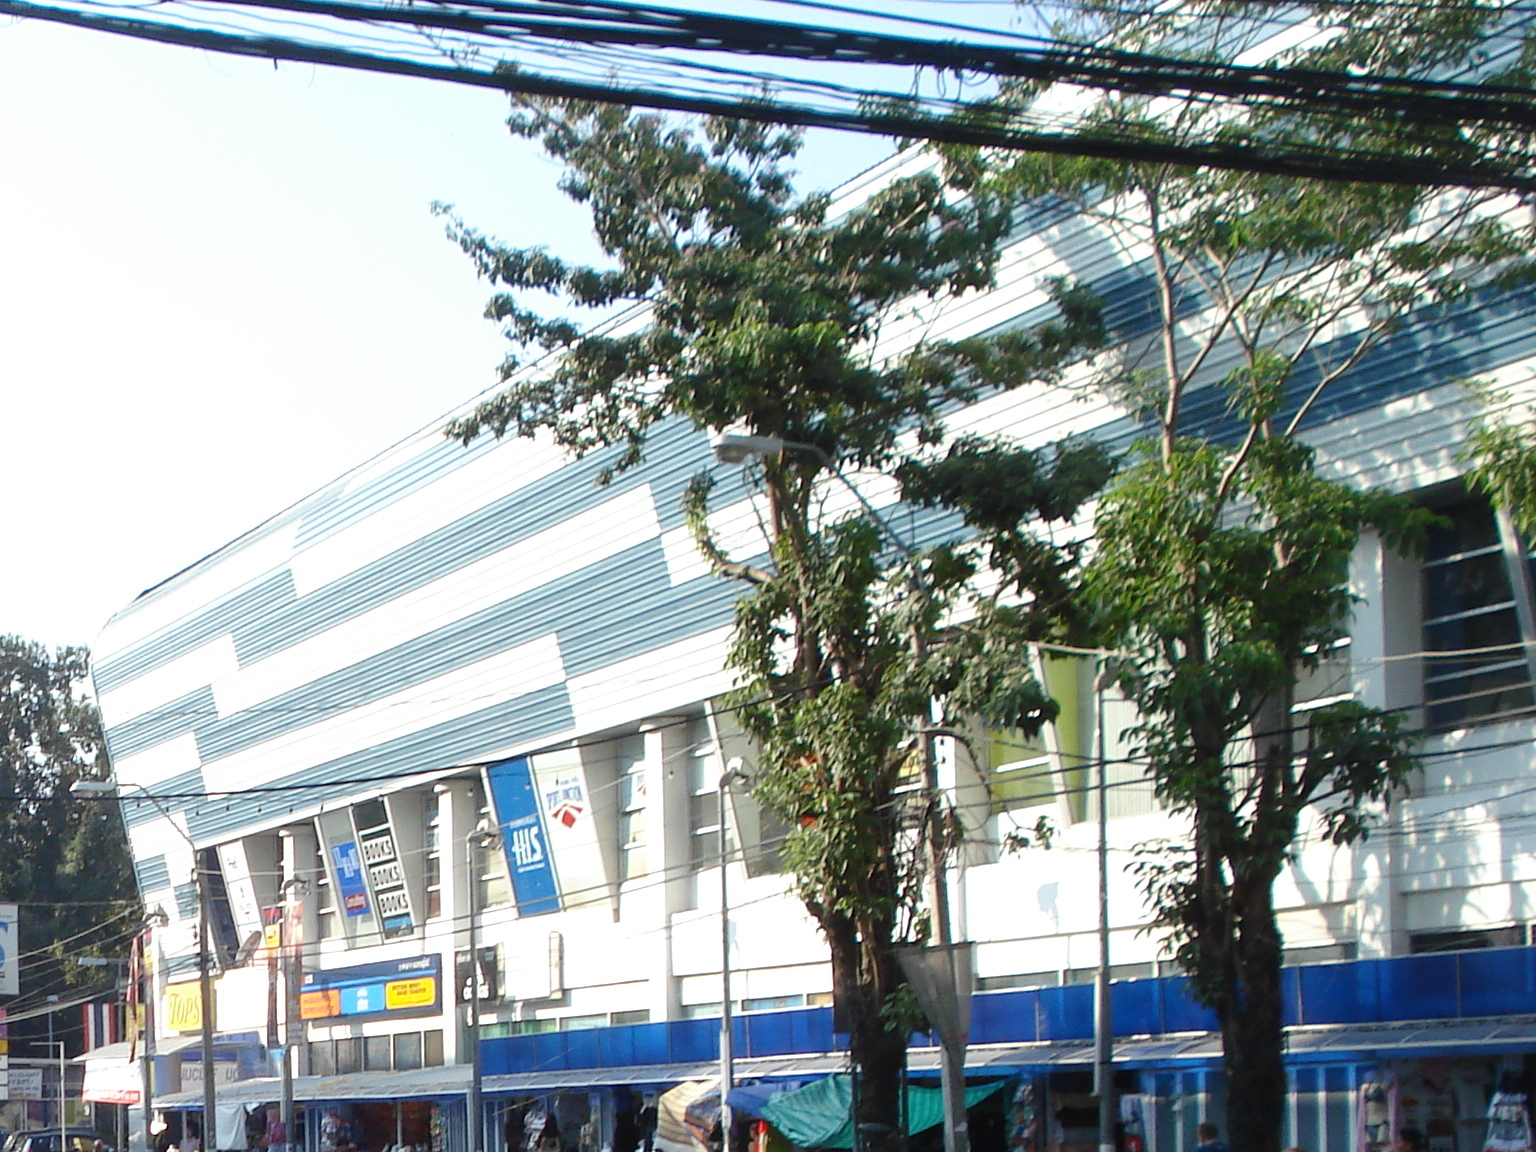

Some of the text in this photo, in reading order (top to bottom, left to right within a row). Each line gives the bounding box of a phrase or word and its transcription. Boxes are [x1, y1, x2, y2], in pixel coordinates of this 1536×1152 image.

[364, 840, 394, 861] BOOKS
[372, 866, 401, 887] BOOKS
[380, 893, 410, 914] BOOKS
